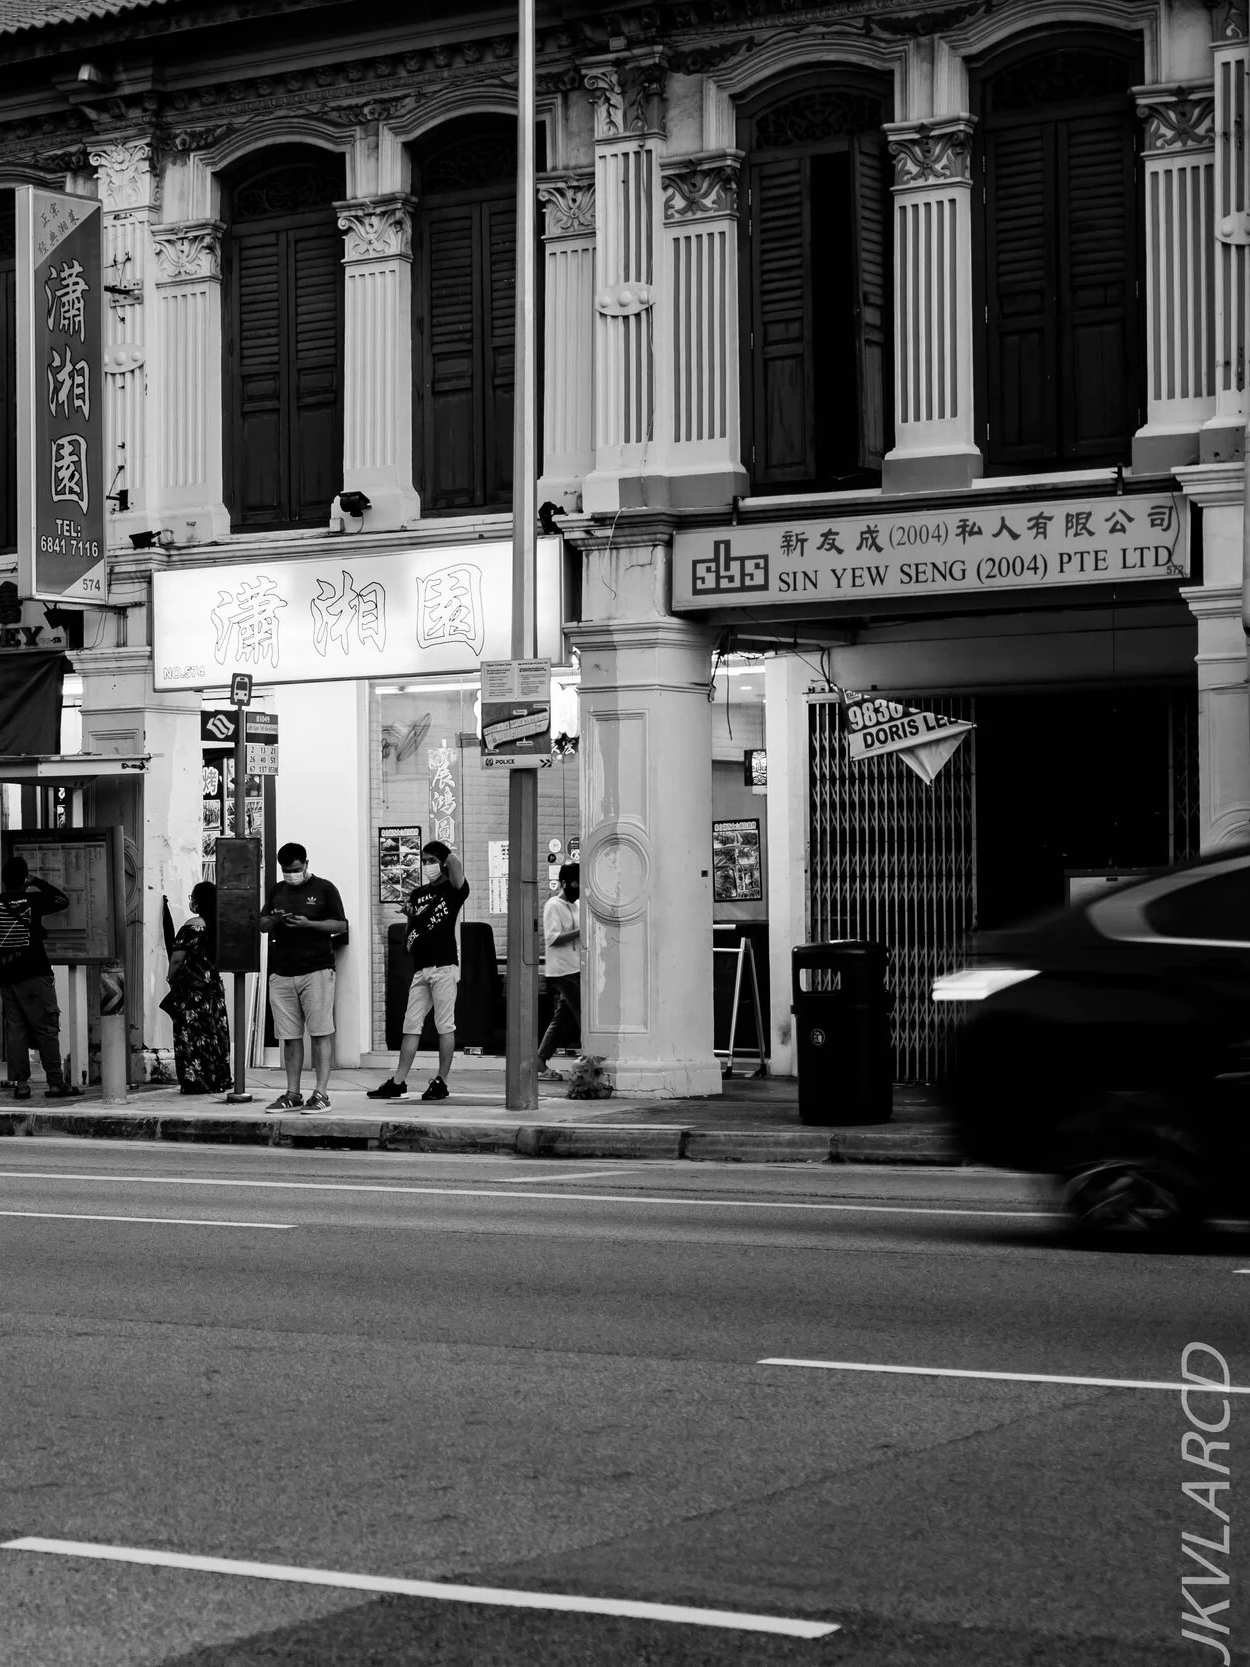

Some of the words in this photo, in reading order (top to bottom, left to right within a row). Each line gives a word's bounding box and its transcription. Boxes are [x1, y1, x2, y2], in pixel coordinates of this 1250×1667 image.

[44, 258, 90, 516] 瀟湘園
[55, 518, 82, 537] TEL:
[40, 535, 67, 554] 6841
[70, 539, 99, 558] 7116
[778, 570, 819, 593] SIN
[830, 565, 890, 589] YEW
[900, 560, 967, 585] SENG
[977, 554, 1048, 584] (2004)
[1058, 550, 1109, 573] PTE
[1121, 545, 1172, 570] LTD
[82, 578, 101, 592] 574
[210, 562, 485, 669] 瀟湘園
[163, 665, 206, 680] NO.574
[862, 718, 920, 749] DORIS
